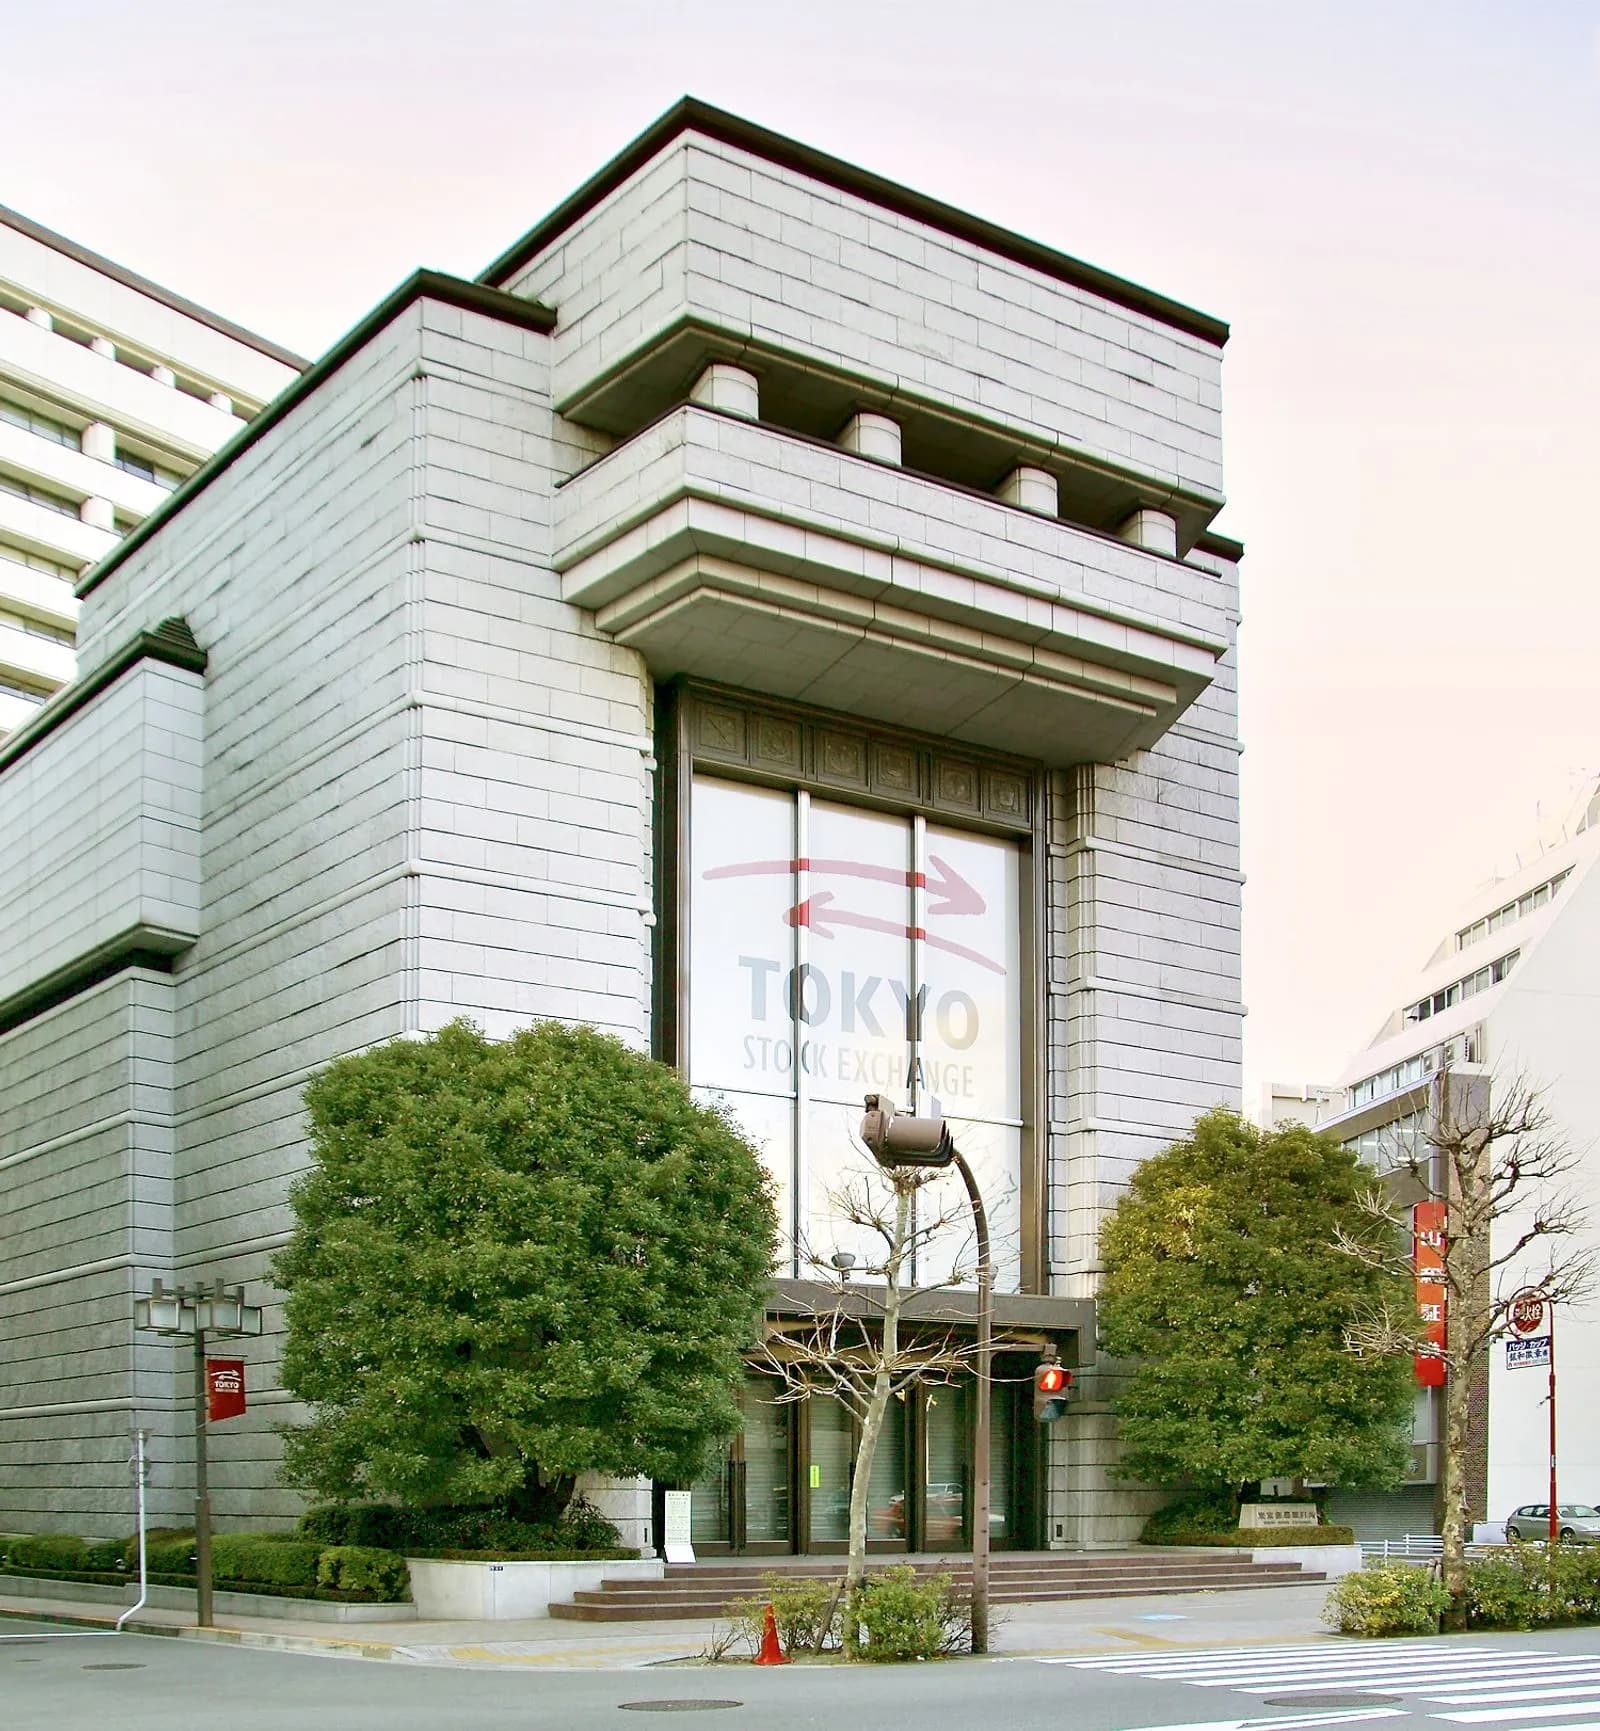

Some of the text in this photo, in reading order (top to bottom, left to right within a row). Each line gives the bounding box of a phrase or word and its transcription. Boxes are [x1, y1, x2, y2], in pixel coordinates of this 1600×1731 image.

[738, 954, 980, 1051] TOKYO
[743, 1034, 975, 1098] STOCK EXCHANGE
[1514, 1302, 1542, 1321] 火栓
[214, 1380, 240, 1389] TOKYO
